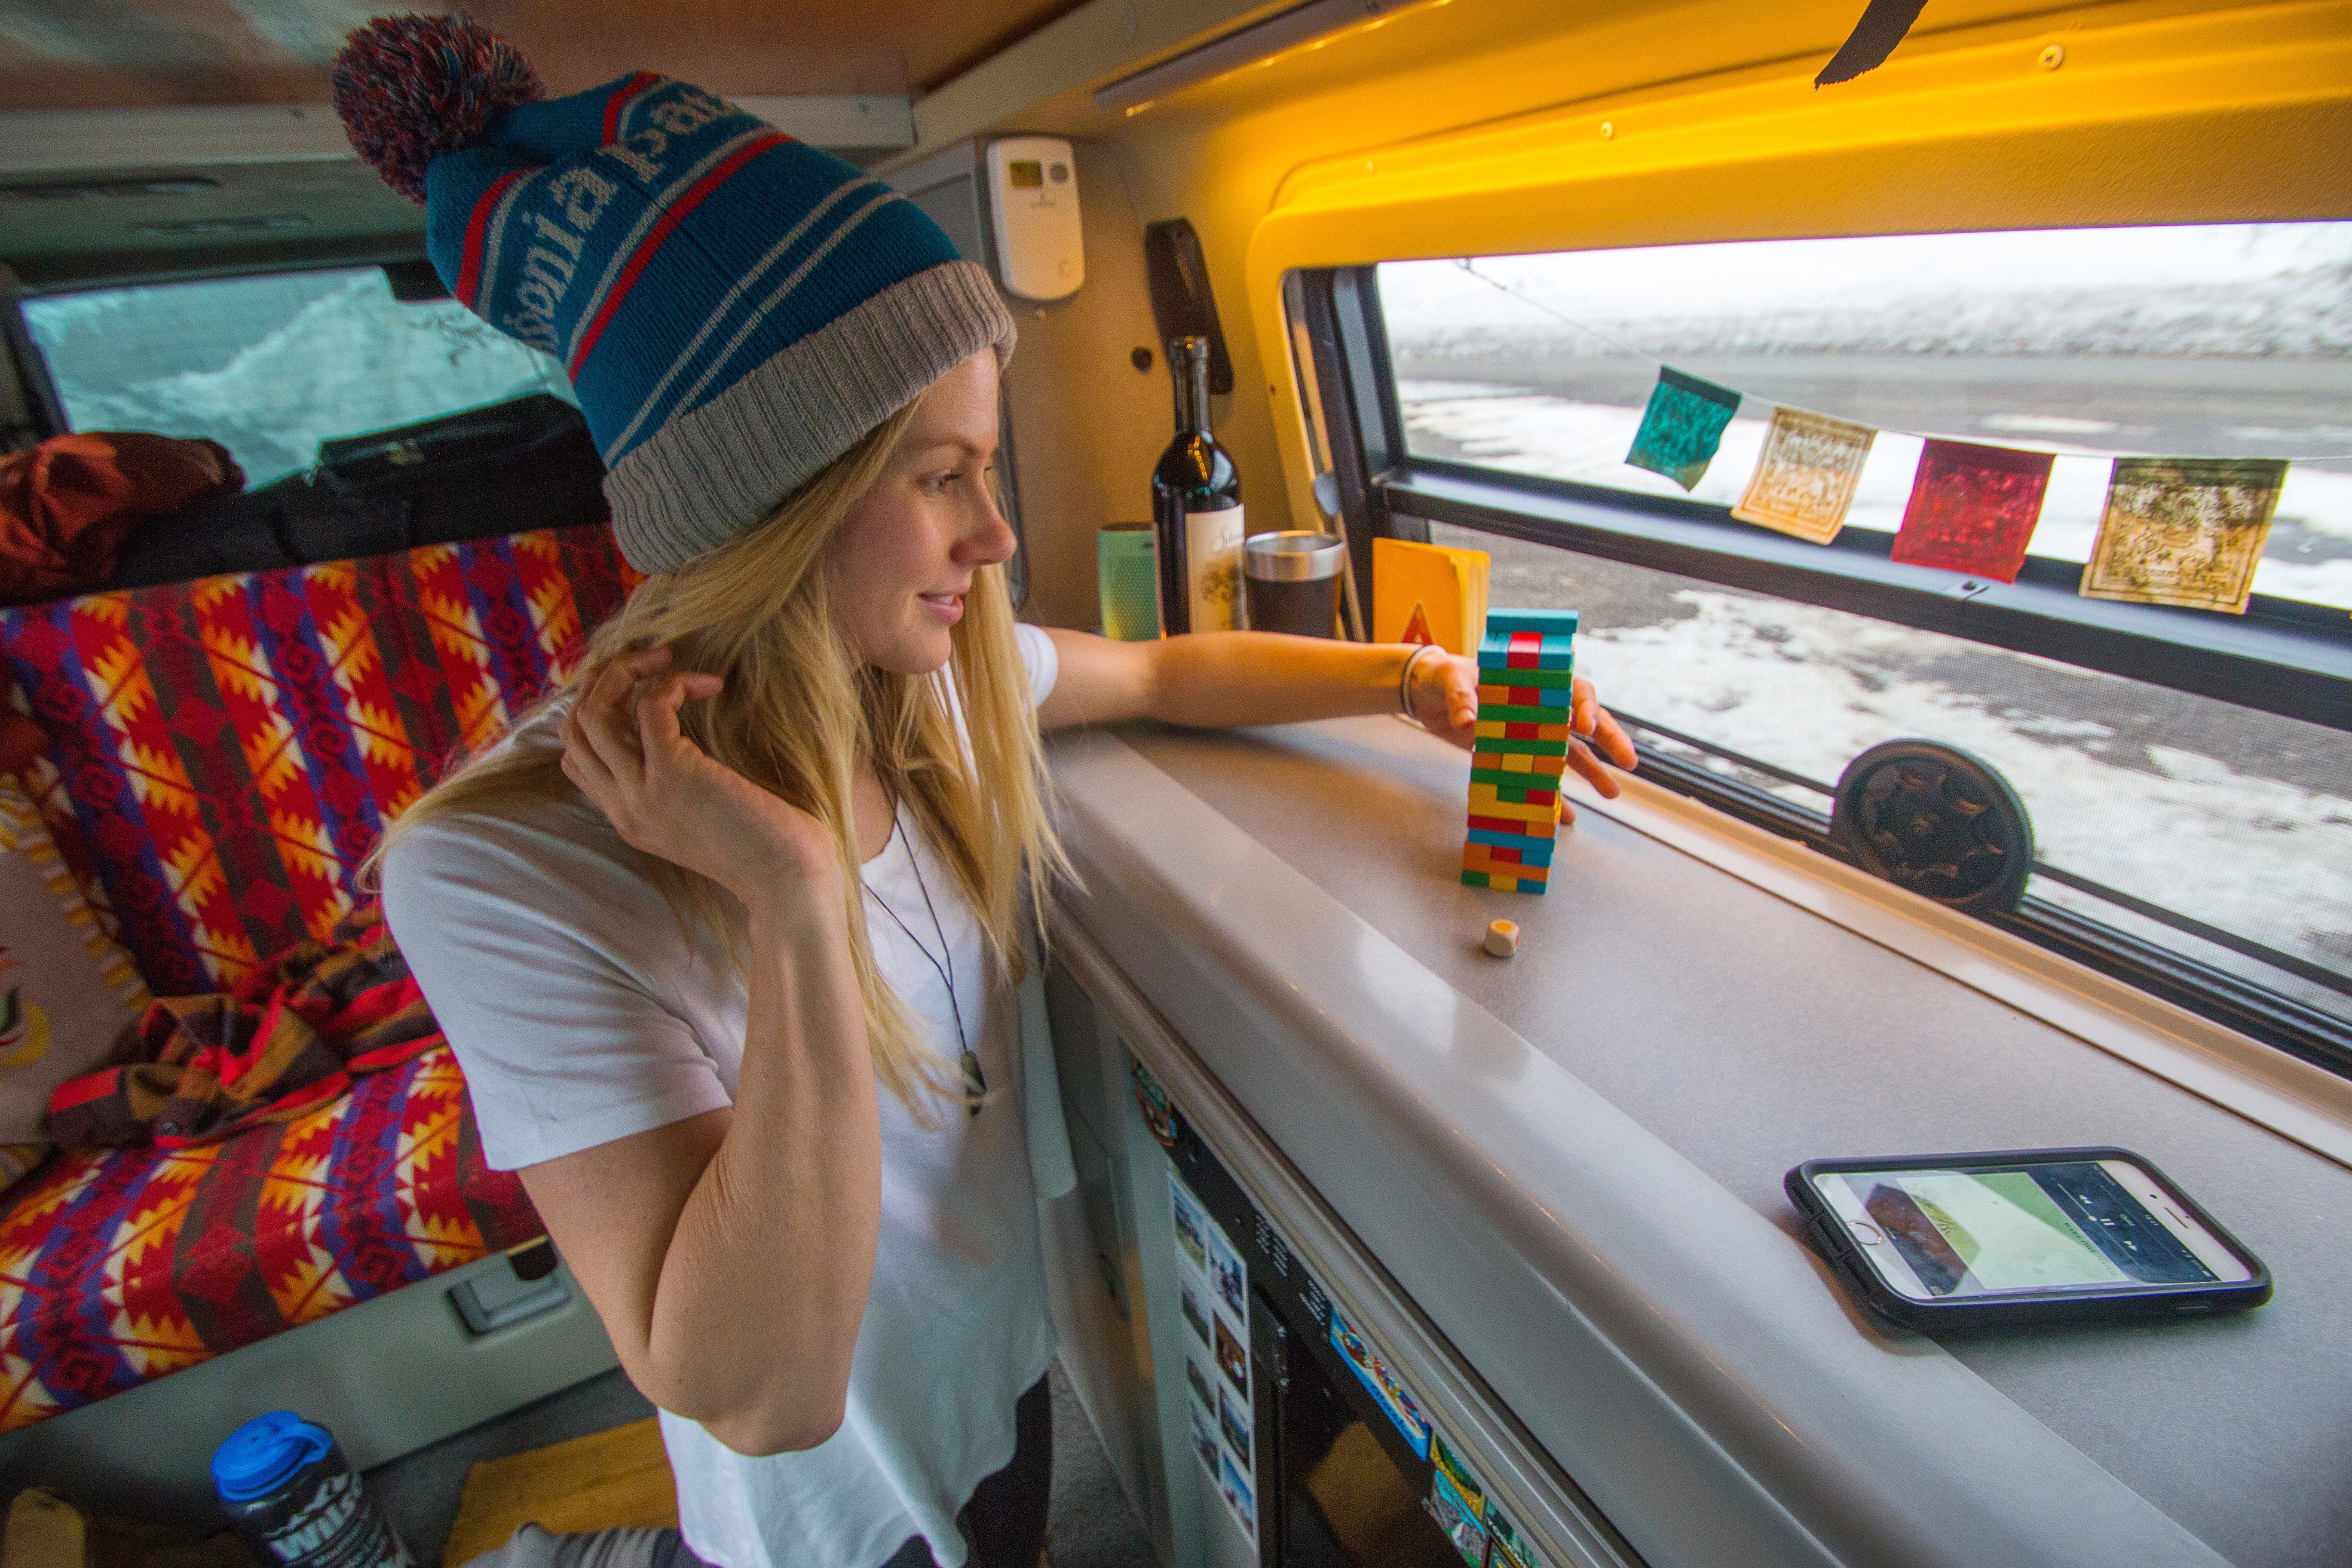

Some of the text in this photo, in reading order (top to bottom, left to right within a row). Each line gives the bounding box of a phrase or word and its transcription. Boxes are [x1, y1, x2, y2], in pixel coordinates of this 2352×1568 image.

[2119, 1213, 2136, 1226] Gold
[2064, 1222, 2081, 1238] WAKE
[2080, 1240, 2096, 1253] OWL
